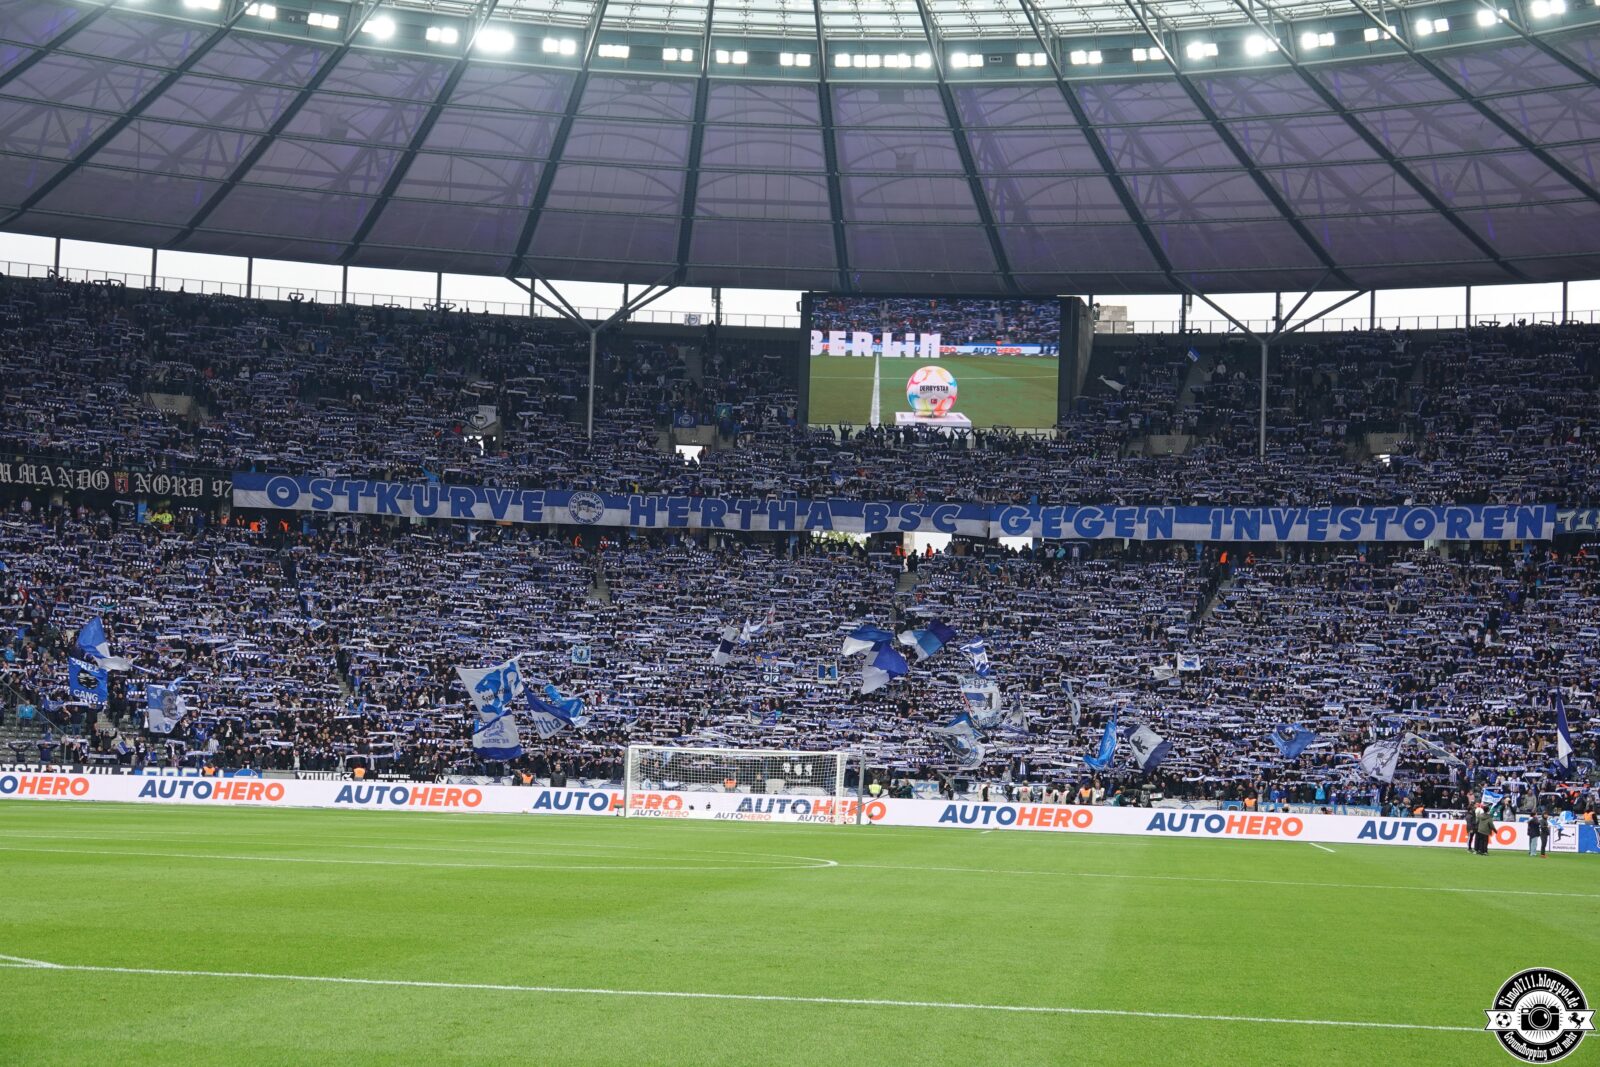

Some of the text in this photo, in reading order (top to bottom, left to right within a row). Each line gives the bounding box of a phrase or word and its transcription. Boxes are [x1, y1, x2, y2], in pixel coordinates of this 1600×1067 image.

[134, 472, 204, 497] NORD
[266, 475, 1547, 541] OSTKURVE HERTHA BSC GEGEN INVESTOREN
[1556, 510, 1600, 532] 71
[138, 779, 285, 801] AUTOHERO
[335, 785, 482, 807] AUTOHERO
[533, 791, 683, 812] AUTOHERO
[632, 809, 690, 818] AUTOHERO
[714, 812, 772, 821] AUTOHERO
[797, 814, 855, 823] AUTOHRO
[938, 804, 1093, 828] AUTOHERO
[1146, 812, 1304, 836] AUTOHERO
[1357, 820, 1517, 845] AUTOHO
